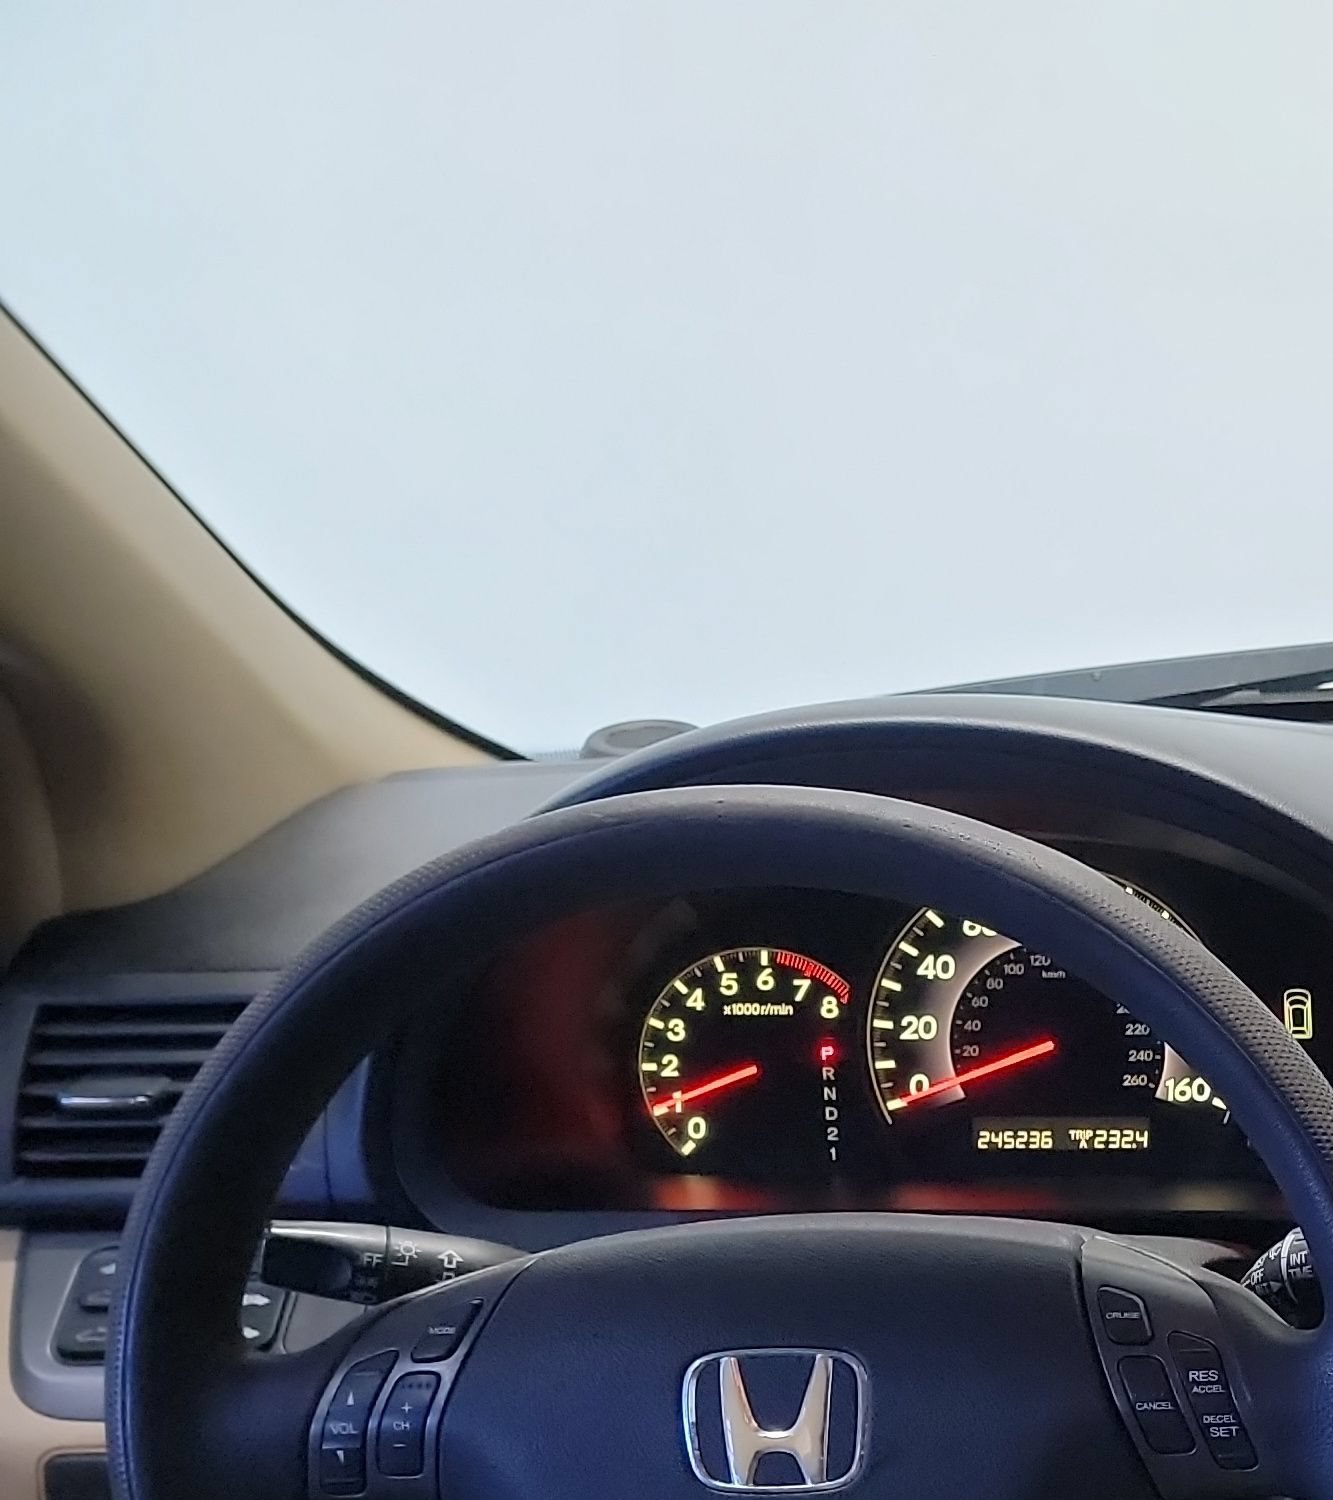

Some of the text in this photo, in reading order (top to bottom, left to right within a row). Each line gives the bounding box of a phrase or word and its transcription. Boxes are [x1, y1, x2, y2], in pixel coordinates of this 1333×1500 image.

[916, 954, 956, 980] 40
[1004, 963, 1025, 976] 100
[719, 972, 739, 995] 5
[756, 968, 775, 991] 6
[986, 978, 1003, 990] 80
[793, 979, 811, 1001] 7
[686, 988, 706, 1011] 4
[971, 996, 989, 1008] 60
[820, 996, 839, 1018] 8
[666, 1019, 686, 1041] 3
[899, 1015, 938, 1041] 20
[964, 1020, 981, 1032] 40
[1125, 1023, 1150, 1036] 220
[821, 1046, 834, 1060] P
[962, 1045, 979, 1057] 20
[1128, 1051, 1153, 1063] 240
[660, 1054, 680, 1077] 2
[823, 1067, 835, 1081] R
[1122, 1074, 1147, 1086] 260
[909, 1074, 930, 1097] 0
[1165, 1077, 1211, 1102] 160
[823, 1087, 836, 1101] N
[673, 1090, 682, 1113] 1
[825, 1107, 838, 1121] D
[687, 1117, 706, 1139] 0
[827, 1127, 840, 1141] 2
[977, 1130, 1053, 1149] 245236
[1094, 1129, 1149, 1149] 232.4
[830, 1147, 837, 1160] 1
[1189, 1370, 1219, 1382] RES
[1192, 1385, 1225, 1393] ACCEL
[1136, 1402, 1175, 1411] CANCEL
[393, 1421, 410, 1431] CH
[1203, 1415, 1236, 1423] DECEL
[329, 1422, 359, 1435] VOL
[1210, 1426, 1240, 1438] SET
